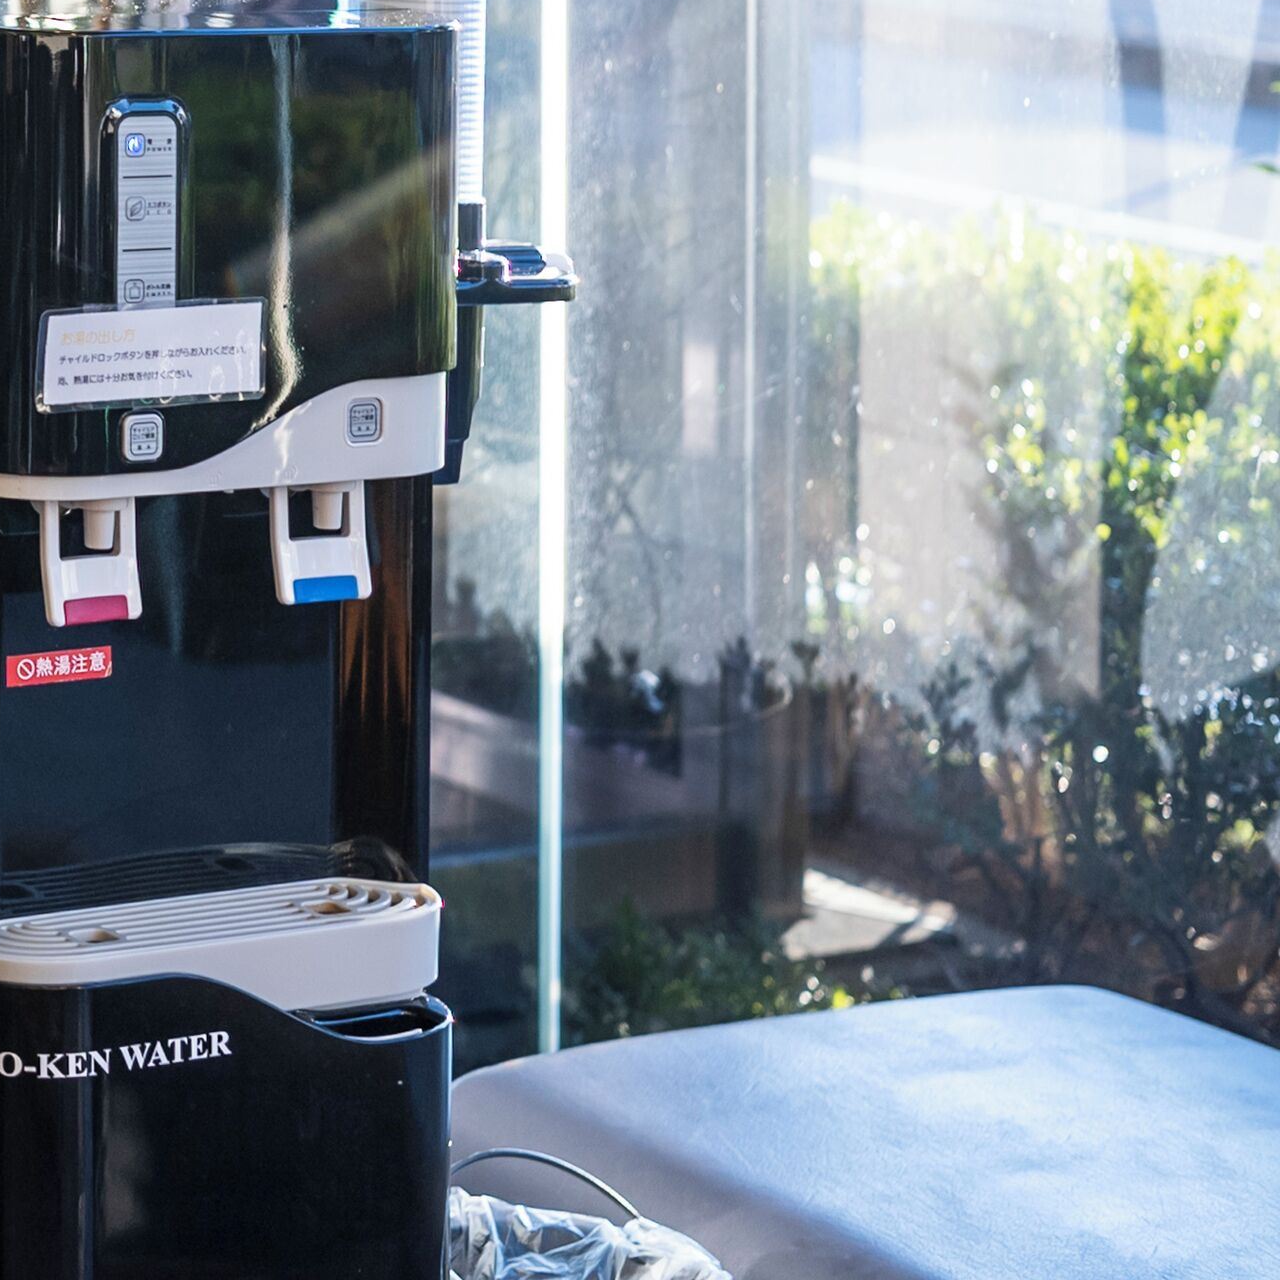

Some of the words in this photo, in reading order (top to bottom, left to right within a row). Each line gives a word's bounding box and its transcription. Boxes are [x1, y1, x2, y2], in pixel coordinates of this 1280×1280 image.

[35, 651, 106, 678] 熱湯注意
[119, 1030, 233, 1070] WATER
